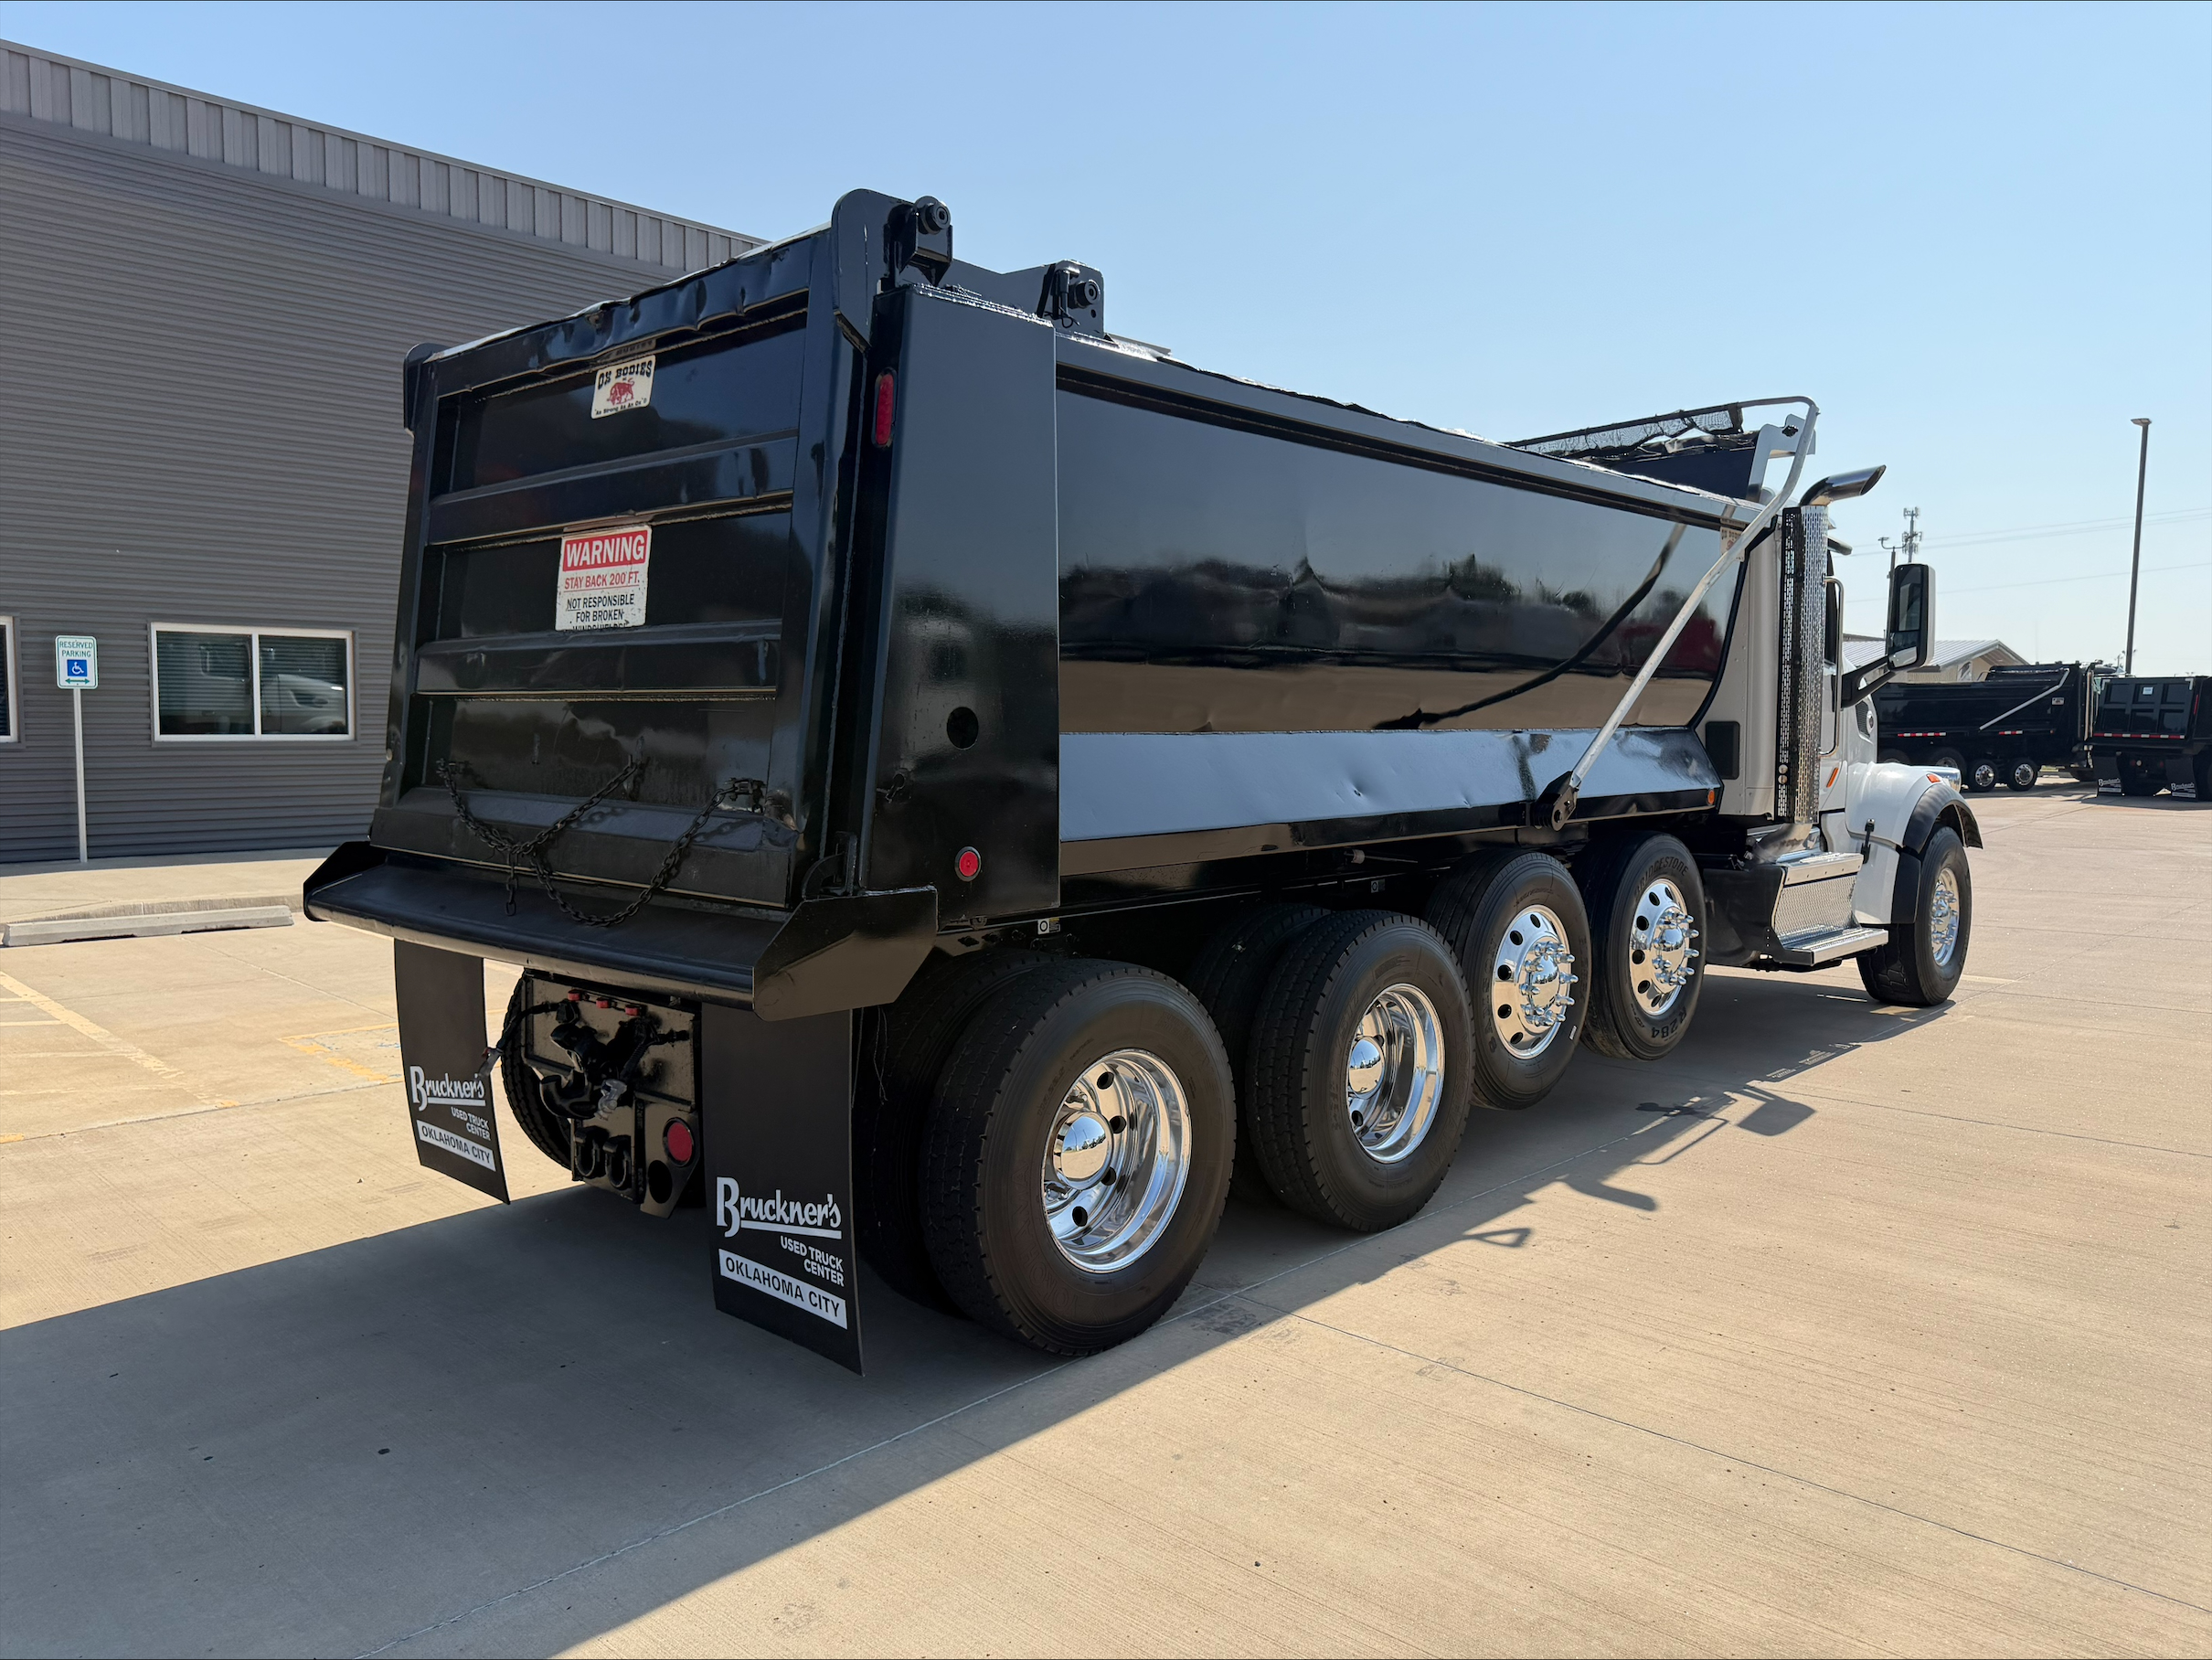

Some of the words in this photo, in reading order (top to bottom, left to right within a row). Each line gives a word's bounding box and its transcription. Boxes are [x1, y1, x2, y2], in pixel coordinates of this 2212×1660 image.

[598, 370, 611, 390] OX
[615, 359, 653, 378] BODIES
[566, 534, 645, 568] WARNING
[564, 576, 584, 590] STAY
[585, 574, 608, 588] BACK
[610, 572, 626, 585] 200
[627, 570, 640, 584] FT.
[567, 598, 581, 610] NOT
[582, 593, 634, 609] RESPONSIBLE
[576, 611, 590, 622] FOR
[592, 608, 624, 622] BROKEN
[59, 641, 93, 649] RESERVED
[61, 650, 91, 658] PARKING
[1634, 856, 1689, 899] BRIDGESTONE
[409, 1066, 485, 1112] Bruckner's
[451, 1106, 468, 1122] USED
[468, 1112, 489, 1130] TRUCK
[466, 1123, 492, 1141] CENTER
[421, 1125, 470, 1155] OKLAHOMA
[471, 1145, 491, 1164] CITY
[716, 1176, 842, 1238] Bruckner's
[780, 1235, 807, 1257] USED
[808, 1246, 845, 1272] TRUCK
[726, 1257, 804, 1302] OKLAHOMA
[808, 1291, 840, 1318] CITY
[803, 1259, 845, 1287] CENTER
